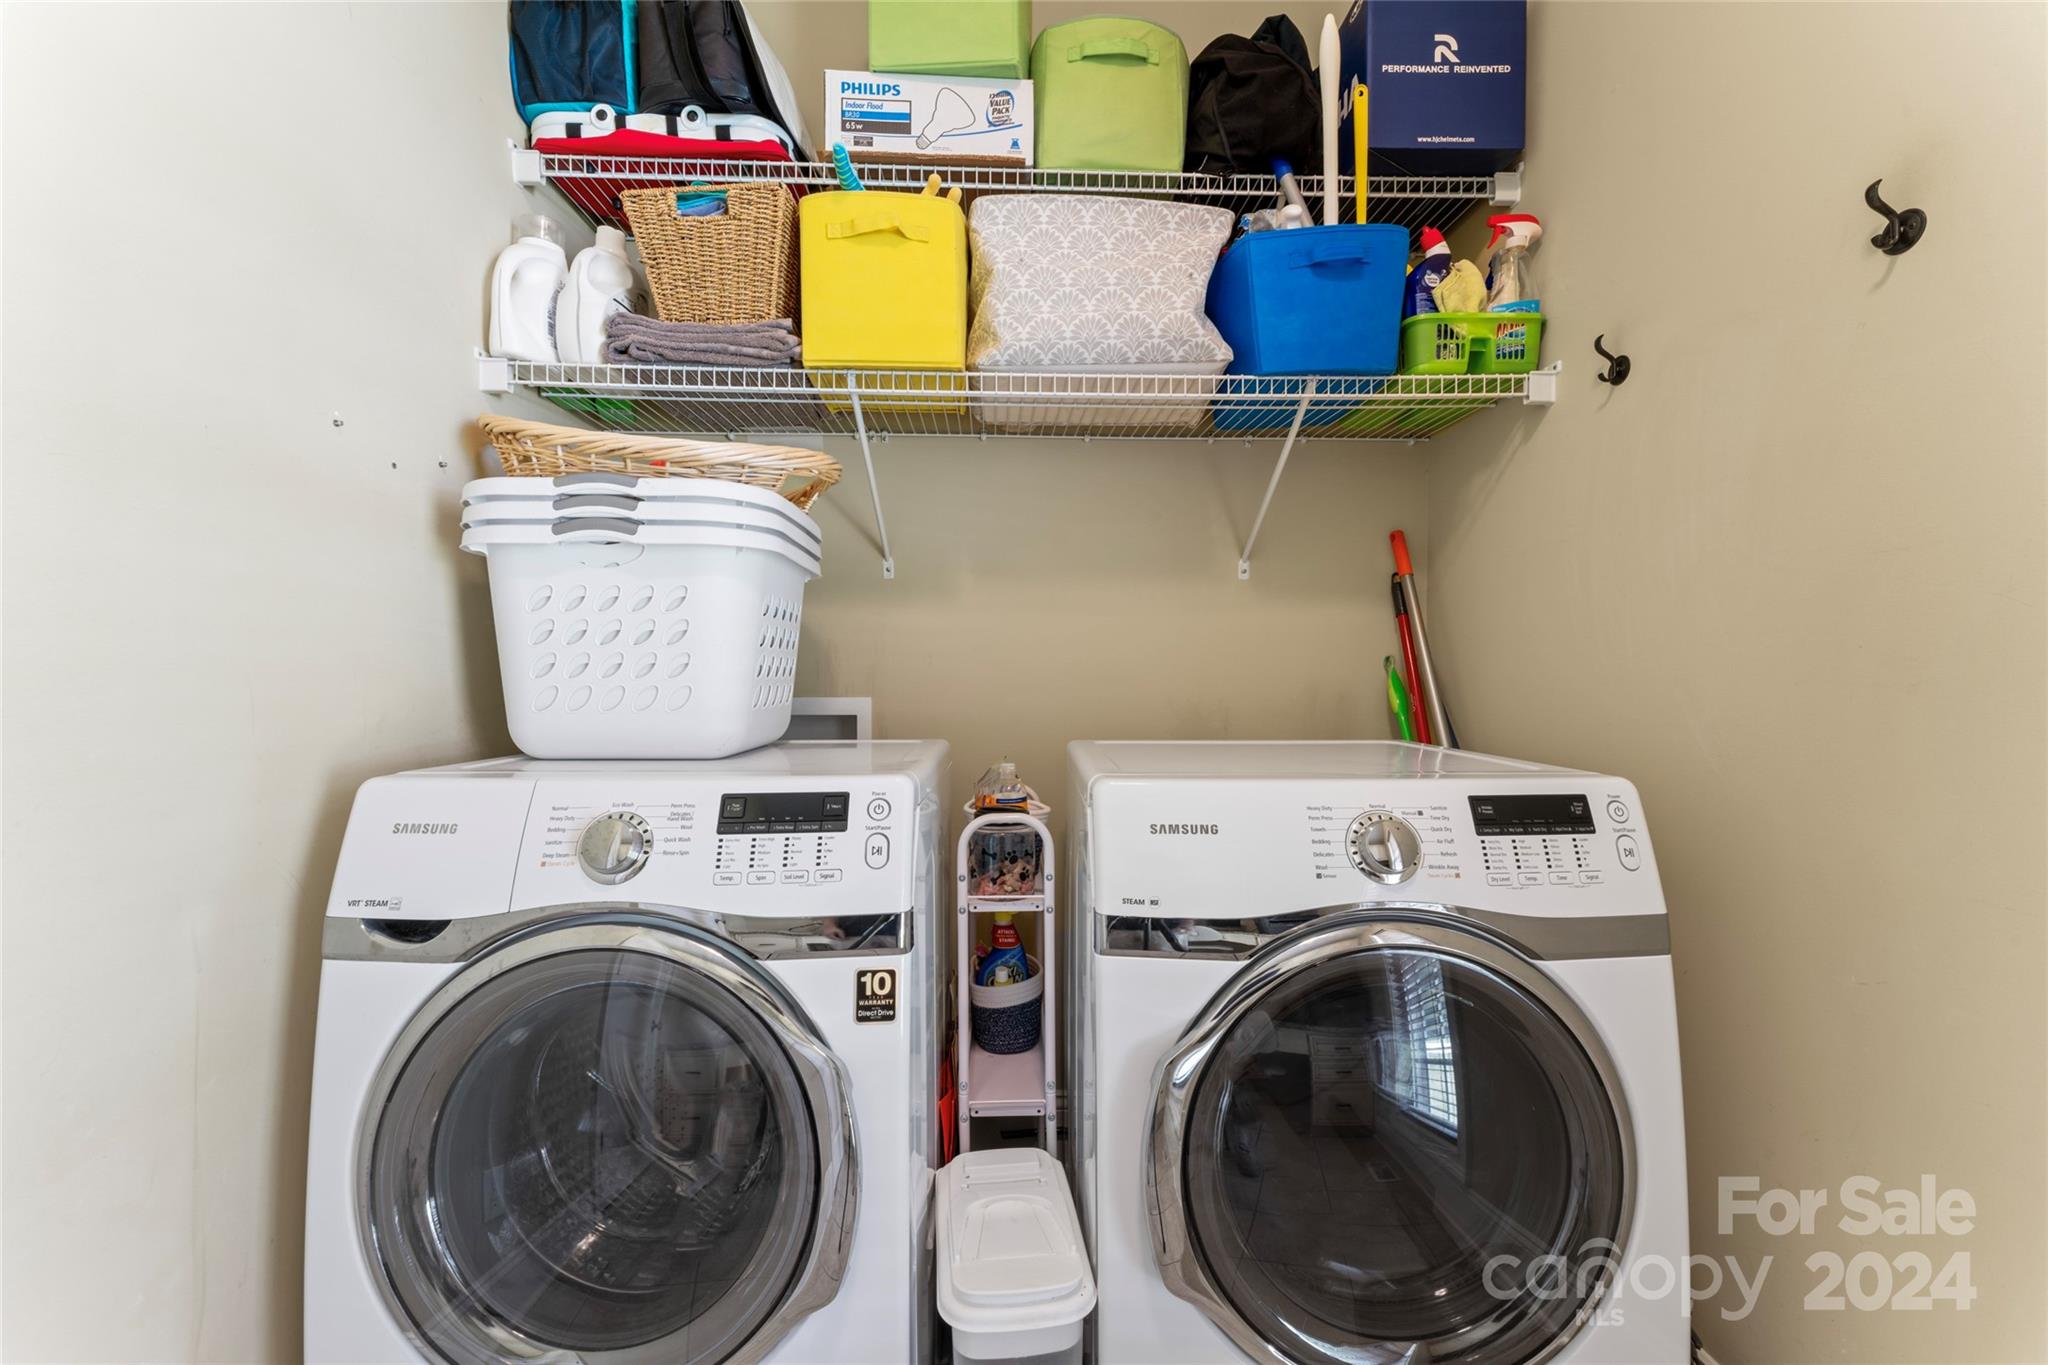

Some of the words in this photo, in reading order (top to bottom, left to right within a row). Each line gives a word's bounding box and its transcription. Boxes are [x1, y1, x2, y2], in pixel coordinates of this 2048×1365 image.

[1381, 64, 1449, 74] PERFORMANCE
[1453, 64, 1512, 74] REINVENTED
[841, 81, 901, 96] PHILIPS
[845, 101, 865, 109] Indoor
[866, 102, 884, 110] Flood
[989, 98, 1011, 107] VALUE
[991, 106, 1011, 116] PACK
[845, 121, 864, 130] 65w
[392, 822, 458, 835] SAMSUNG
[1149, 823, 1219, 835] SAMSUNG
[364, 899, 389, 908] STEAM
[1121, 897, 1146, 906] STEAM
[861, 971, 892, 996] 10
[857, 1009, 877, 1017] Direct
